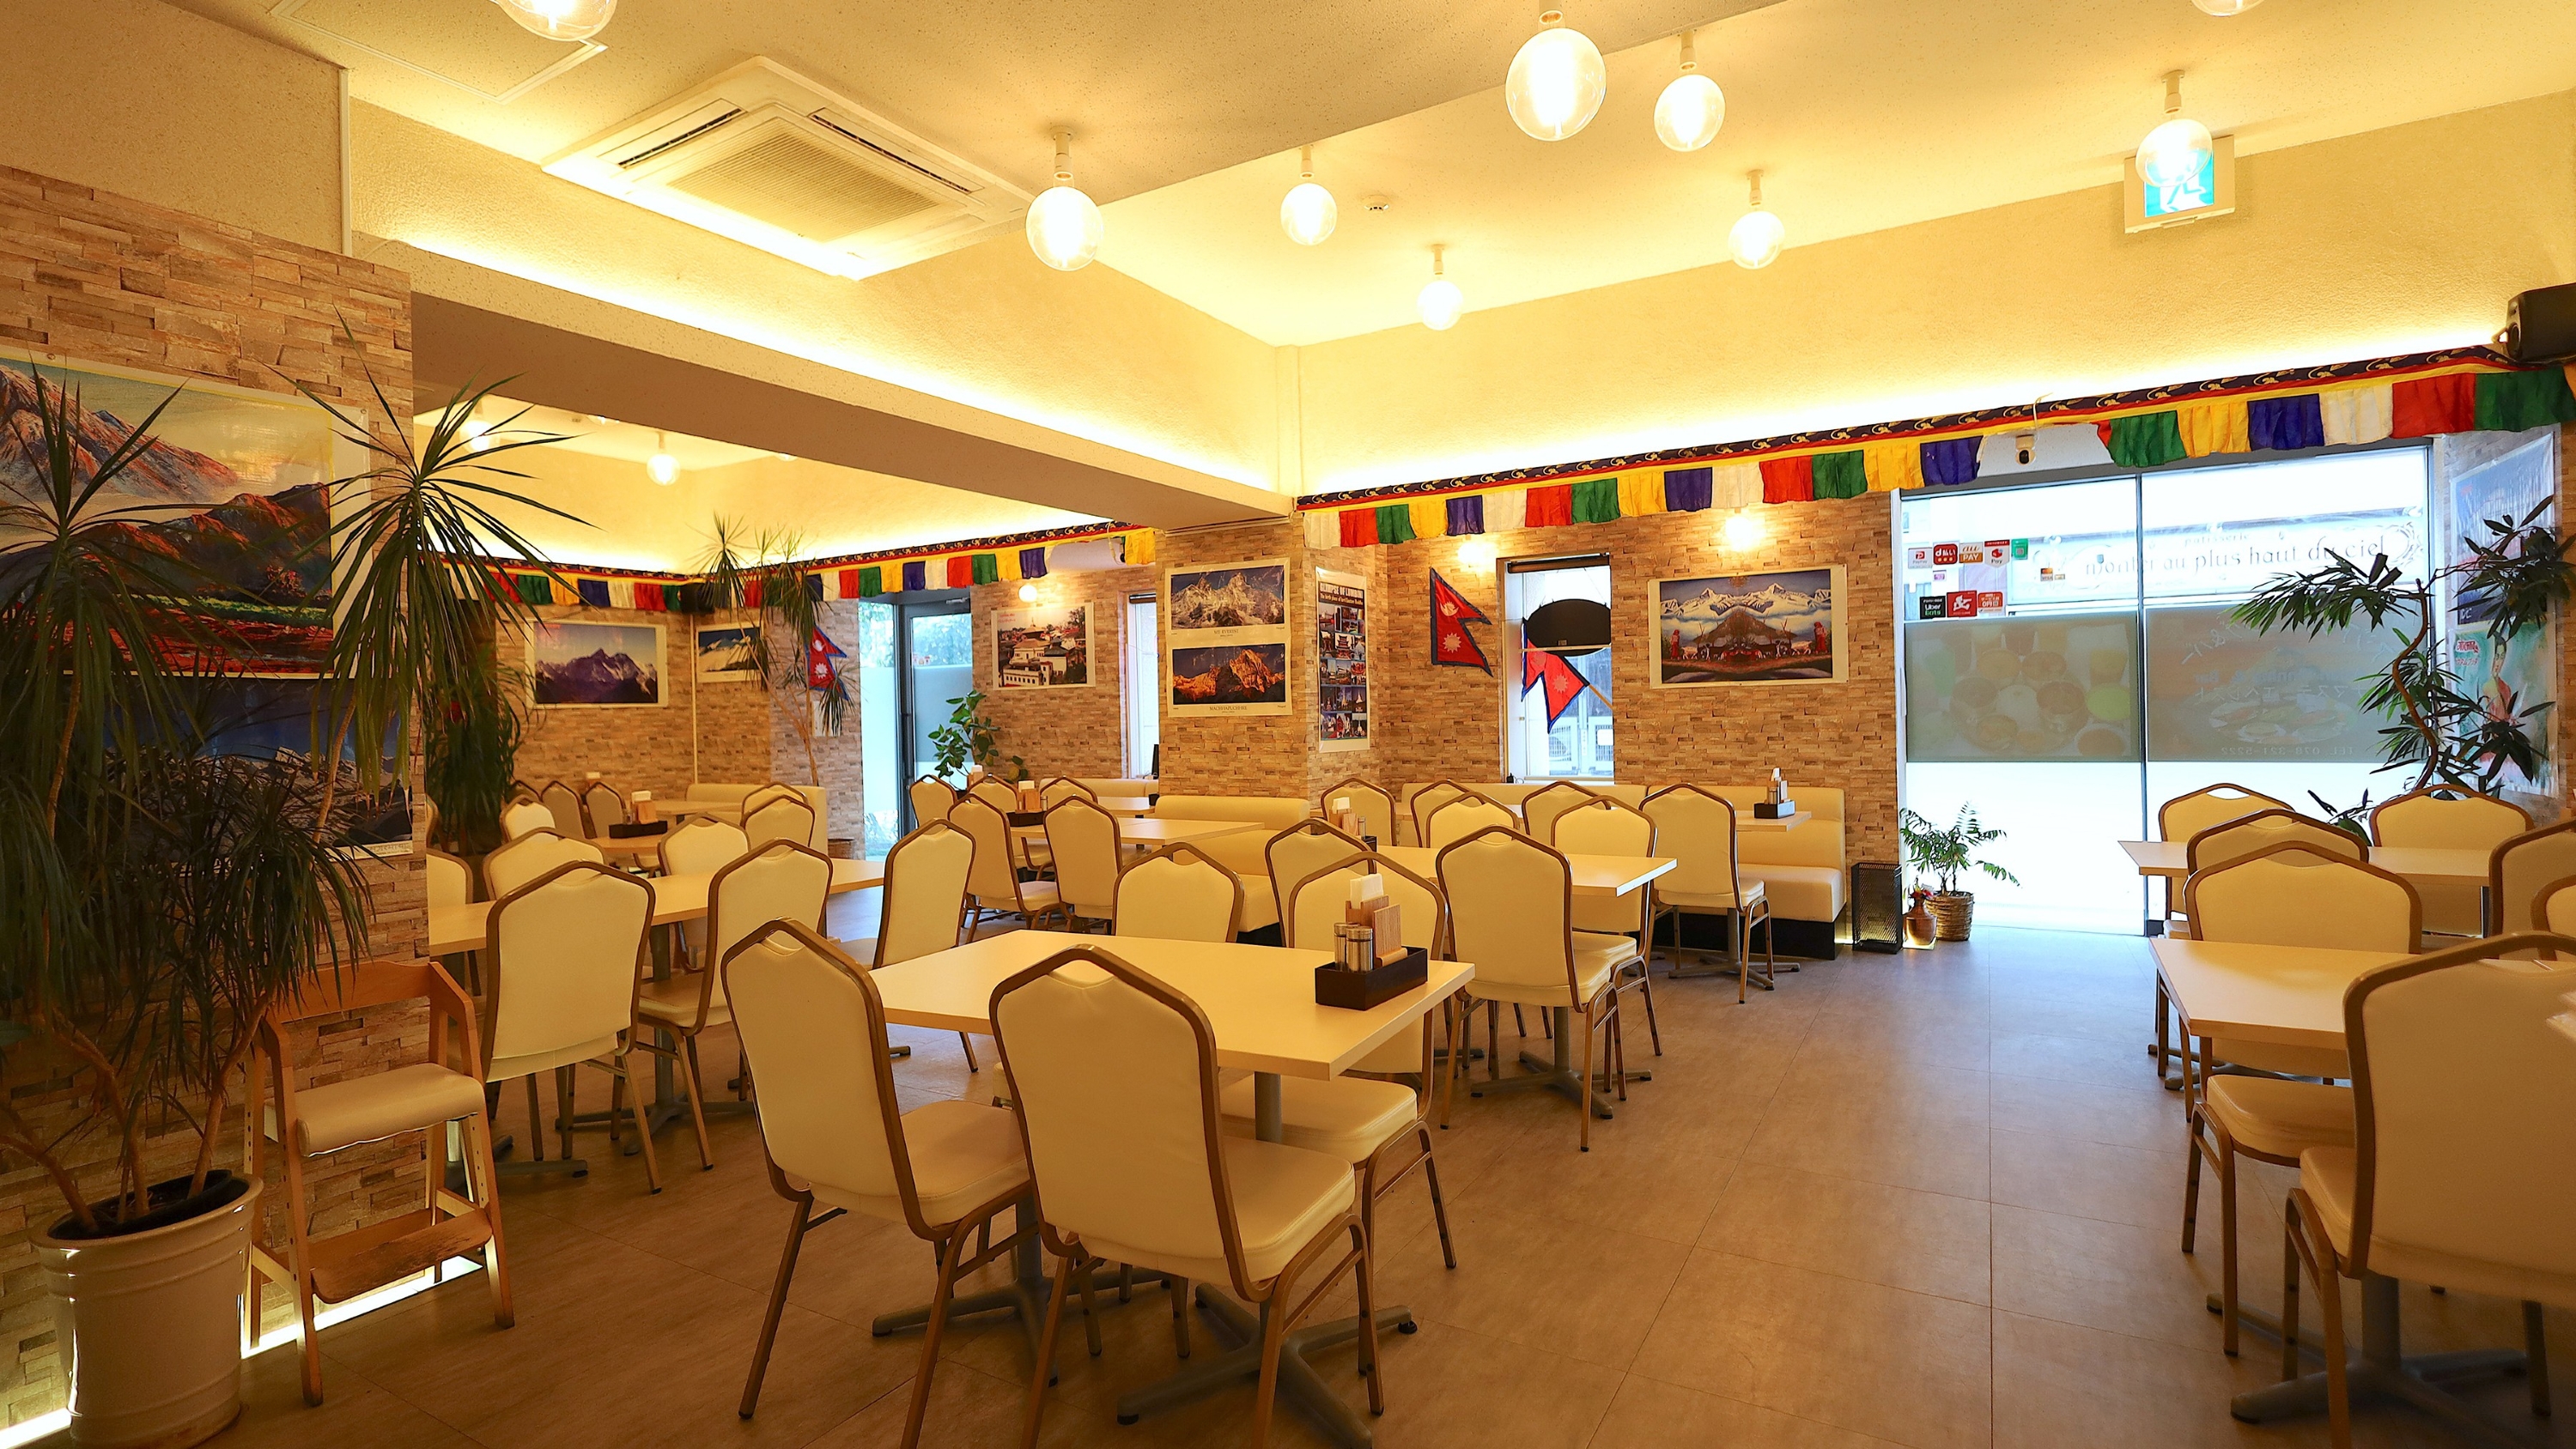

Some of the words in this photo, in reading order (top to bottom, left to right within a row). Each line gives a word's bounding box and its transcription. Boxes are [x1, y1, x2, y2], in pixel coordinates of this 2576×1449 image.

[1963, 553, 1979, 561] PAY
[2086, 555, 2154, 578] montr
[2164, 557, 2185, 571] au
[2195, 549, 2241, 575] plus
[2250, 546, 2298, 565] haut
[2345, 534, 2384, 558] ciel
